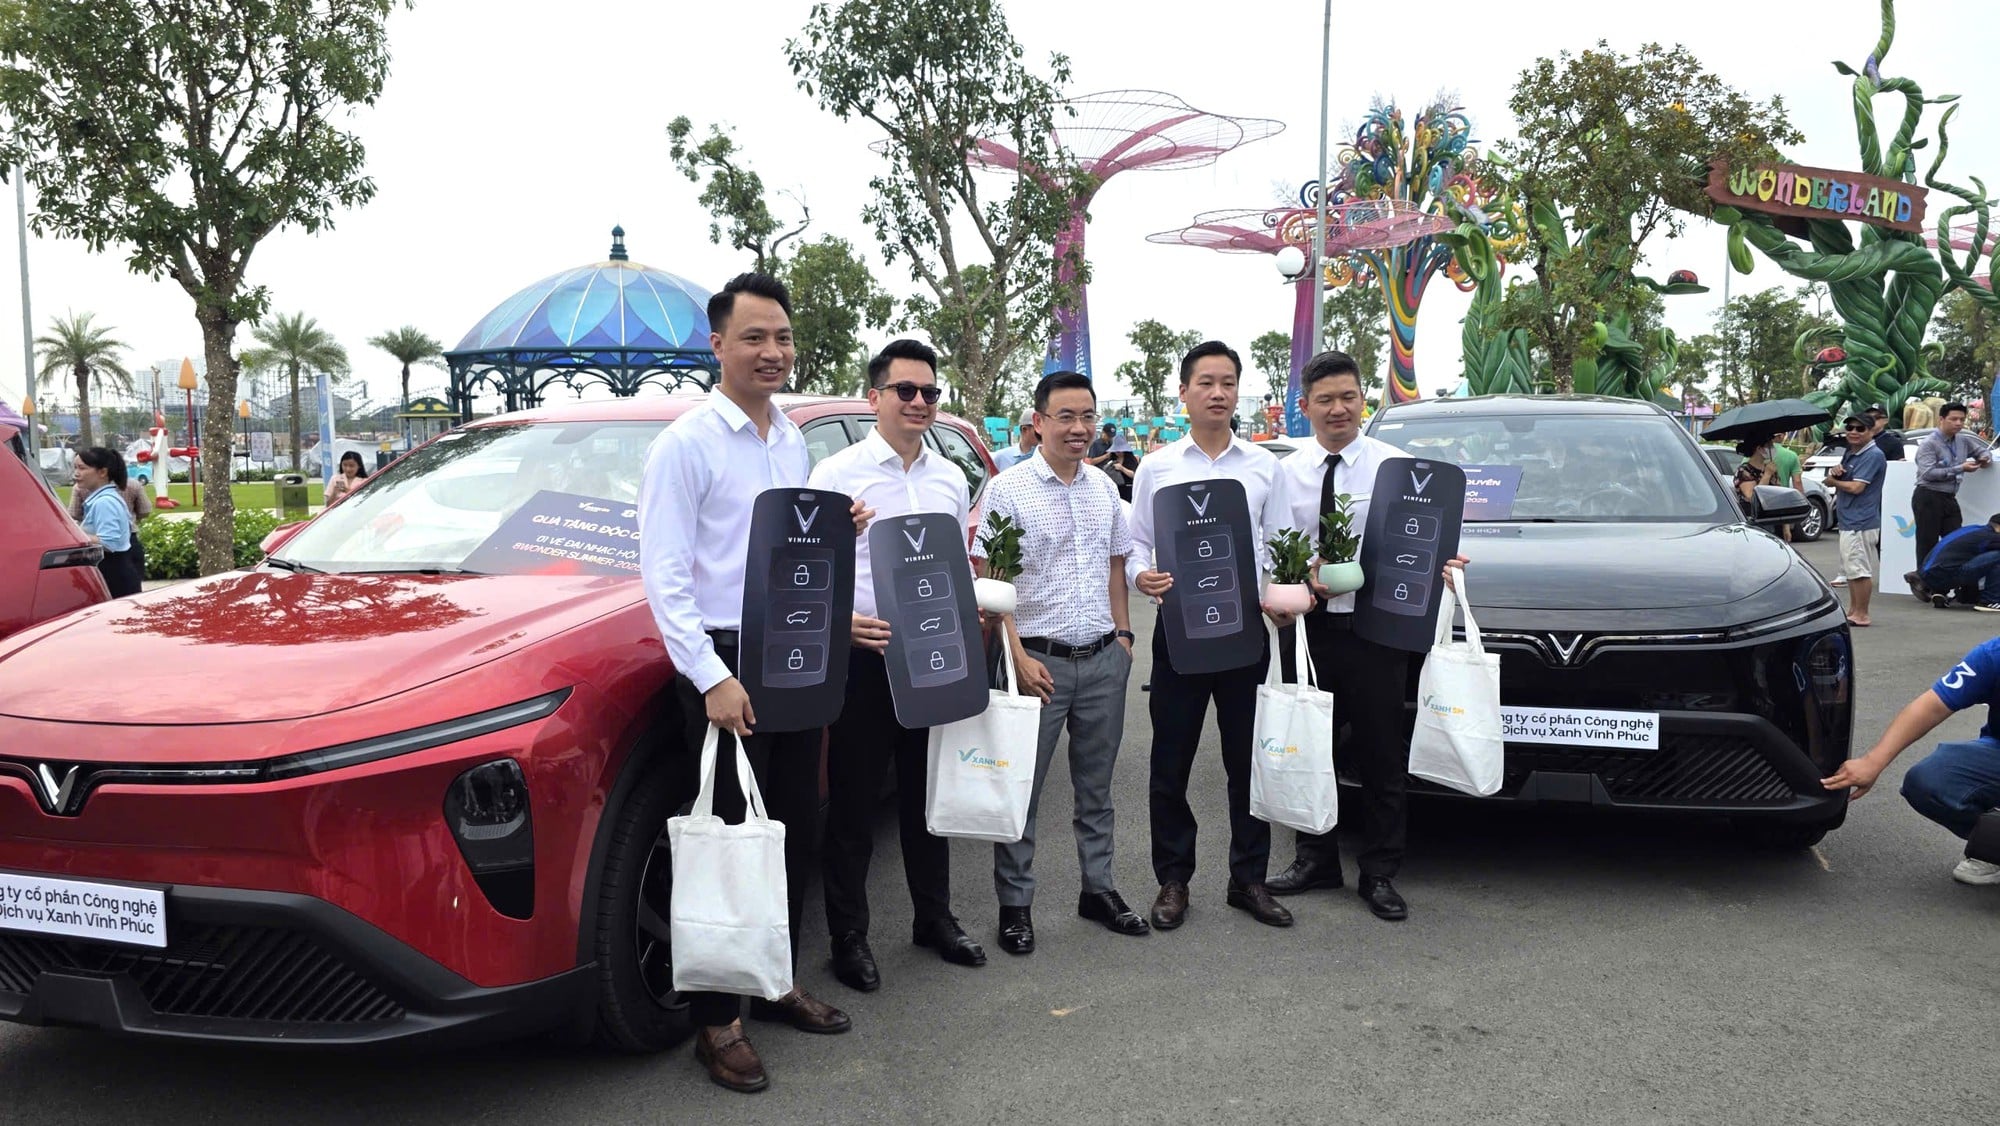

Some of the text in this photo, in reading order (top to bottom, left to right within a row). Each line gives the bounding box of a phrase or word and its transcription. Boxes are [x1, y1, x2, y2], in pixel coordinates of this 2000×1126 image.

[1729, 166, 1912, 222] WONDERLAND
[1403, 495, 1432, 503] VINFAST
[532, 514, 560, 525] QUÀ
[564, 519, 598, 532] TẶNG
[599, 525, 630, 538] ĐỘC
[1187, 517, 1217, 526] VINFAST
[512, 542, 567, 557] 8WONDER
[567, 551, 616, 566] SUMMER
[536, 535, 639, 560] 01 VÉ ĐẠI NHẠC HỘI
[904, 554, 934, 563] VINFAST
[1942, 661, 1977, 689] 3
[1502, 725, 1649, 742] Dịch vụ Xanh Vĩnh Phúc
[1515, 713, 1528, 724] ty
[1531, 713, 1547, 724] cổ
[1550, 714, 1581, 726] phần
[1584, 715, 1618, 729] Công
[1620, 718, 1654, 731] nghệ
[971, 756, 996, 766] XANH
[7, 885, 22, 902] ty
[25, 886, 42, 901] cổ
[45, 889, 80, 906] phần
[83, 892, 119, 914] Công
[122, 900, 157, 918] nghệ
[25, 908, 43, 923] vụ
[46, 908, 82, 925] Xanh
[84, 912, 117, 930] Vĩnh
[121, 916, 155, 934] Phúc
